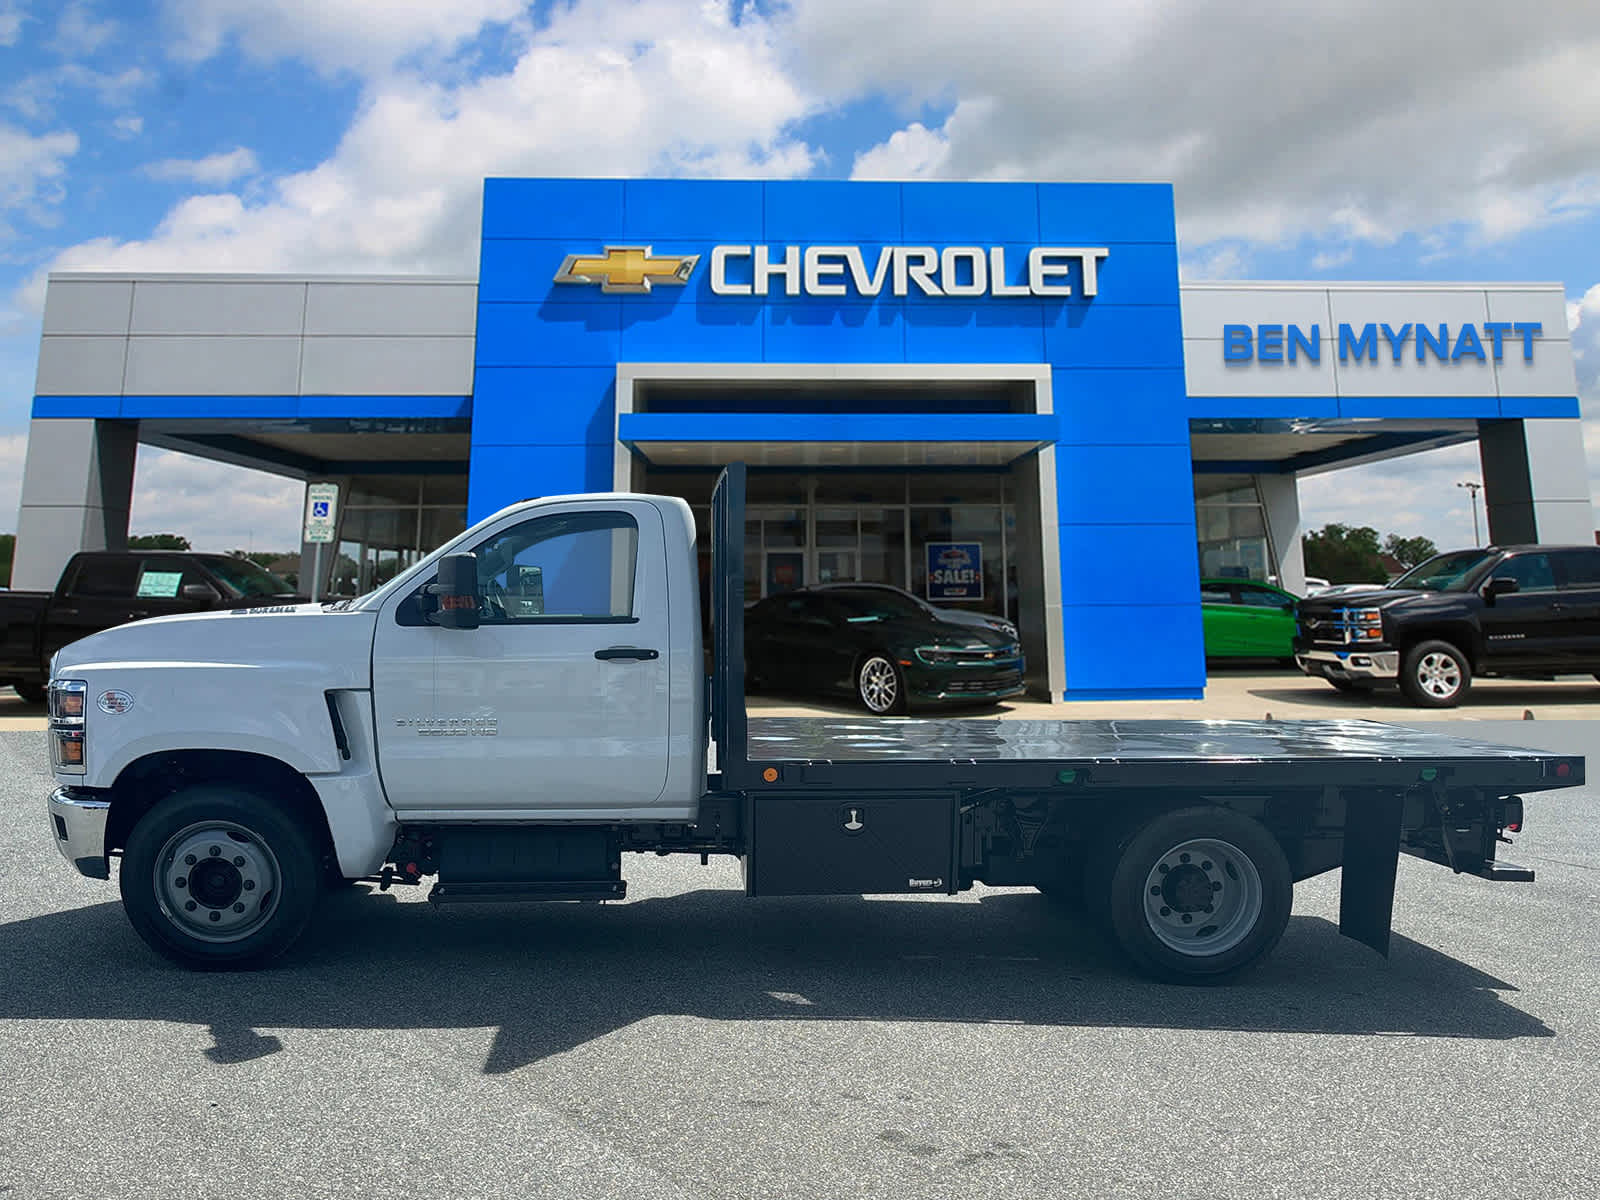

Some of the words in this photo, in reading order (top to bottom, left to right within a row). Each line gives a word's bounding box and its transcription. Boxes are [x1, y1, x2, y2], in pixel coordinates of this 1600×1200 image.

[711, 245, 1110, 297] CHEVROLET
[1223, 324, 1321, 363] BEN
[1338, 322, 1543, 363] MYNATT
[934, 569, 975, 585] SALE!
